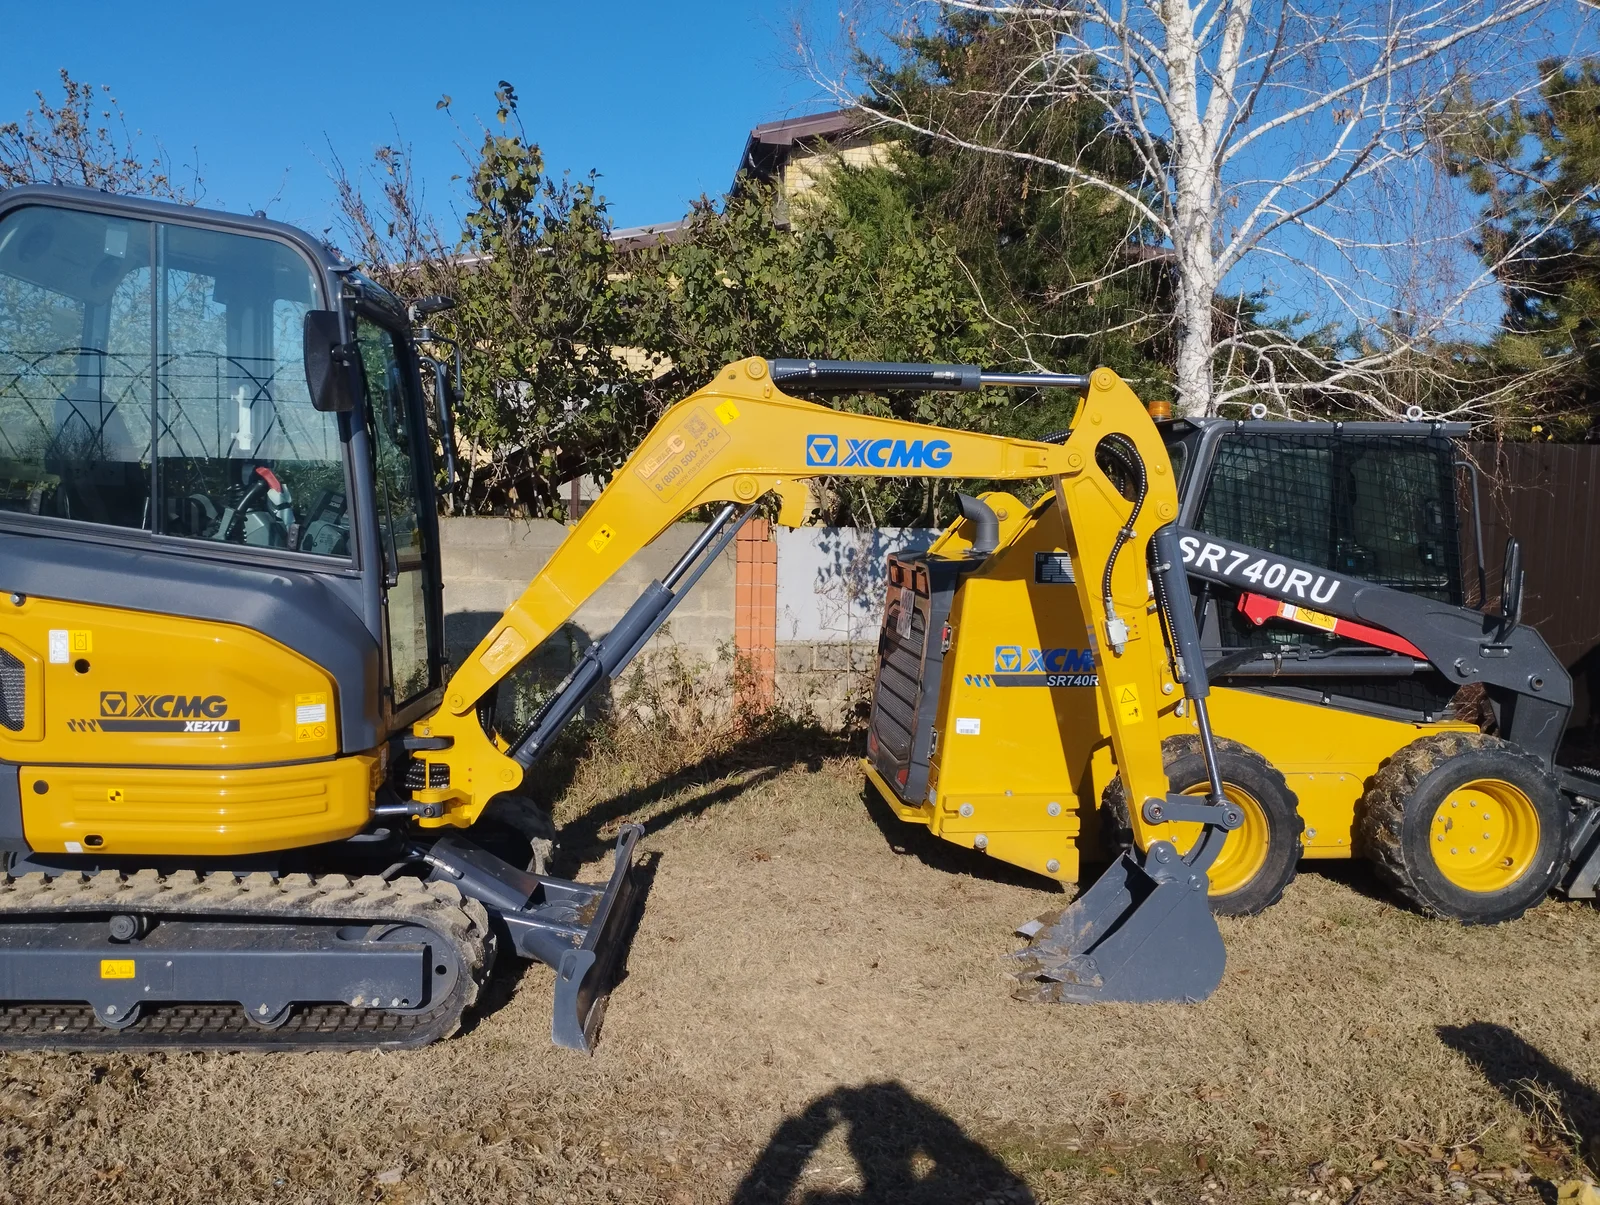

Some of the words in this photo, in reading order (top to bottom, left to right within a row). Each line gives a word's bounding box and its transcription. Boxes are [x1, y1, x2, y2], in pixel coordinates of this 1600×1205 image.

[655, 482, 664, 492] 8
[661, 464, 684, 487] (800)
[680, 427, 720, 467] 500-73-92
[838, 438, 953, 469] XCMG
[1178, 536, 1341, 604] SR740RU
[1022, 648, 1096, 673] XCM
[128, 694, 228, 719] XCMG
[184, 721, 230, 732] XE27U
